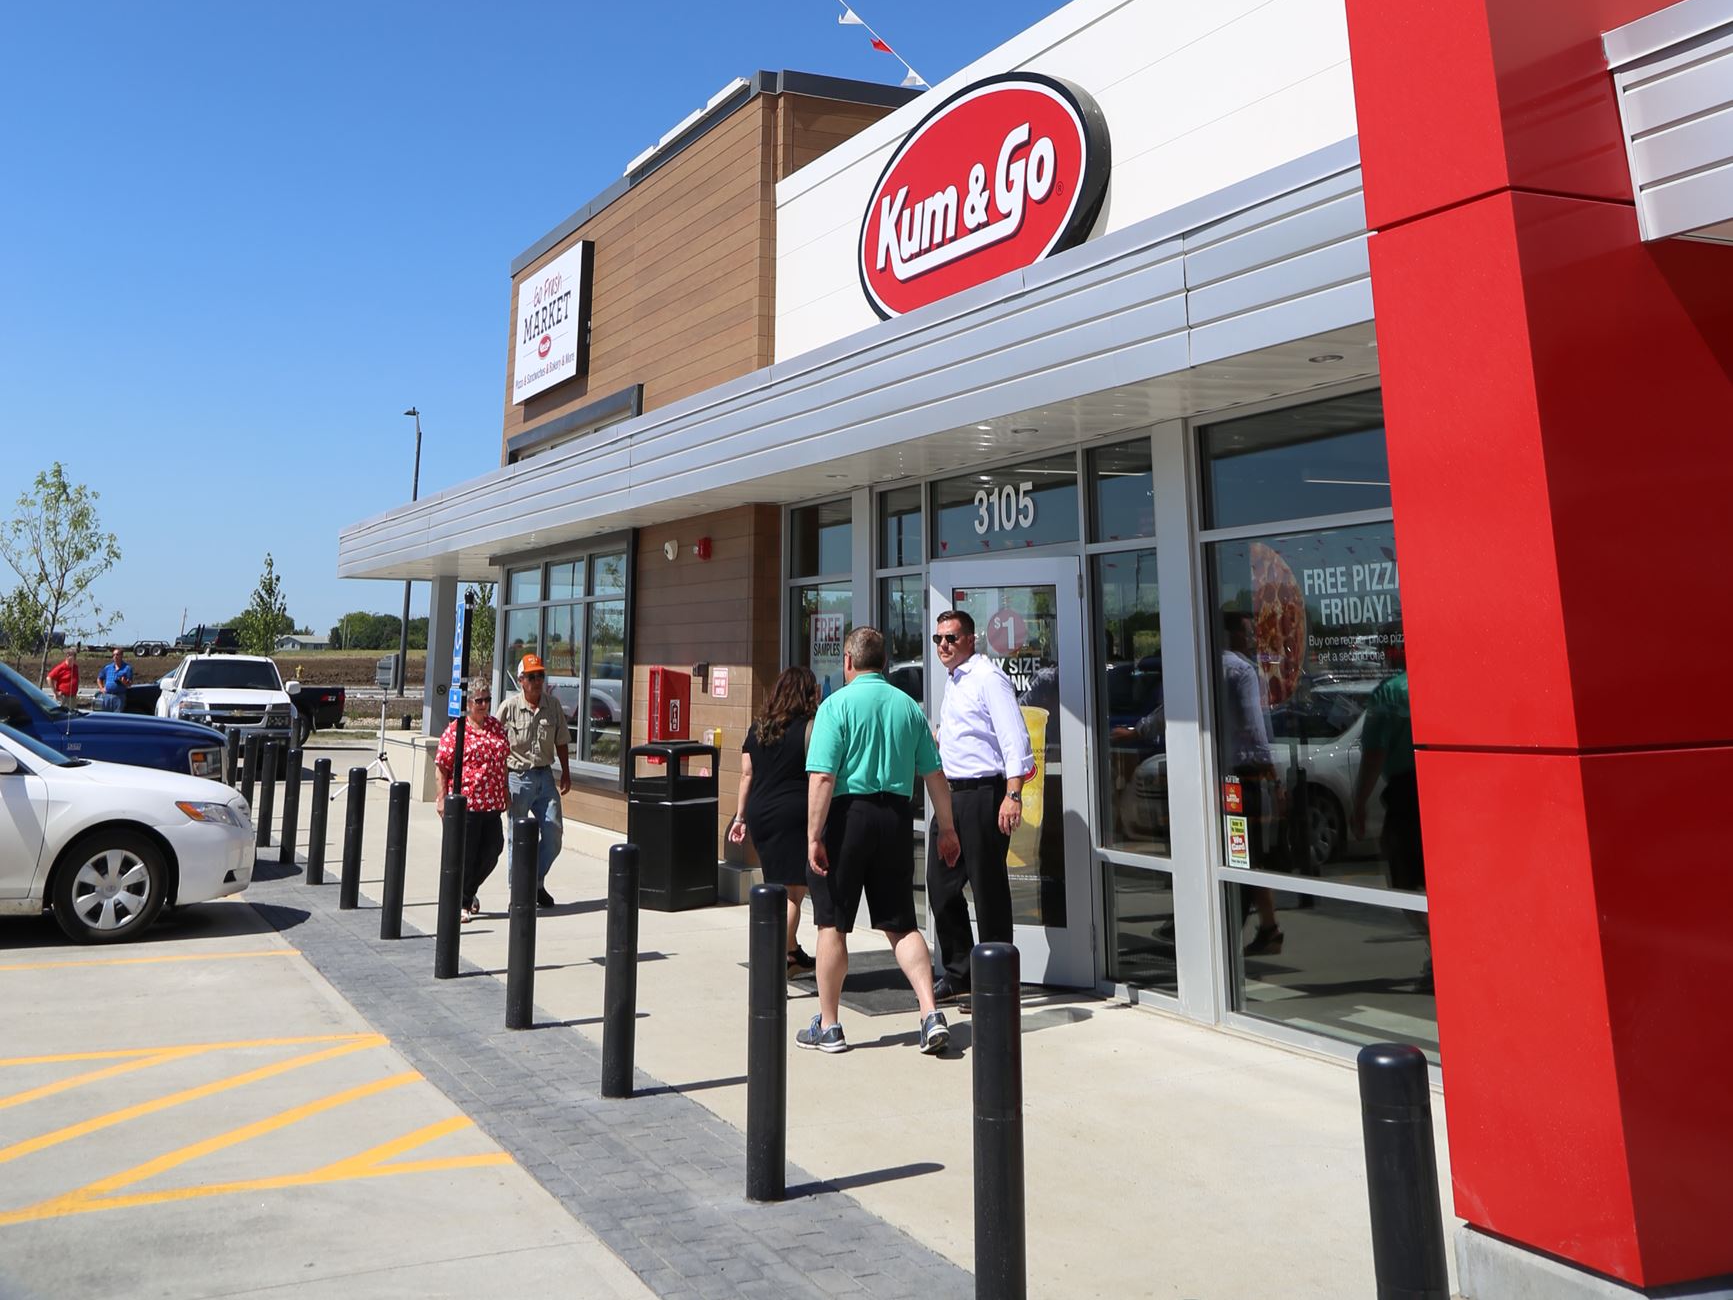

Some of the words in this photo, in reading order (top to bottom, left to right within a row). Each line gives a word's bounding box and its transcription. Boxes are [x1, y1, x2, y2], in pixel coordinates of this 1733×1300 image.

[876, 185, 959, 280] Kum
[963, 163, 991, 231] &
[994, 122, 1057, 224] Go
[544, 272, 562, 300] Fresh
[523, 290, 571, 344] MARKET
[974, 481, 1034, 534] 3105
[1303, 566, 1348, 596] FREE
[1320, 594, 1393, 626] FRIDAY!
[814, 617, 840, 642] FREE
[994, 616, 1015, 650] $1
[1308, 635, 1324, 648] Buy
[1324, 636, 1340, 645] one
[1368, 631, 1388, 647] price
[813, 643, 840, 657] SAMPLES
[1318, 651, 1331, 664] get
[1332, 653, 1338, 661] a
[1339, 650, 1368, 661] second
[1370, 651, 1386, 661] one
[1008, 657, 1041, 675] SIZE
